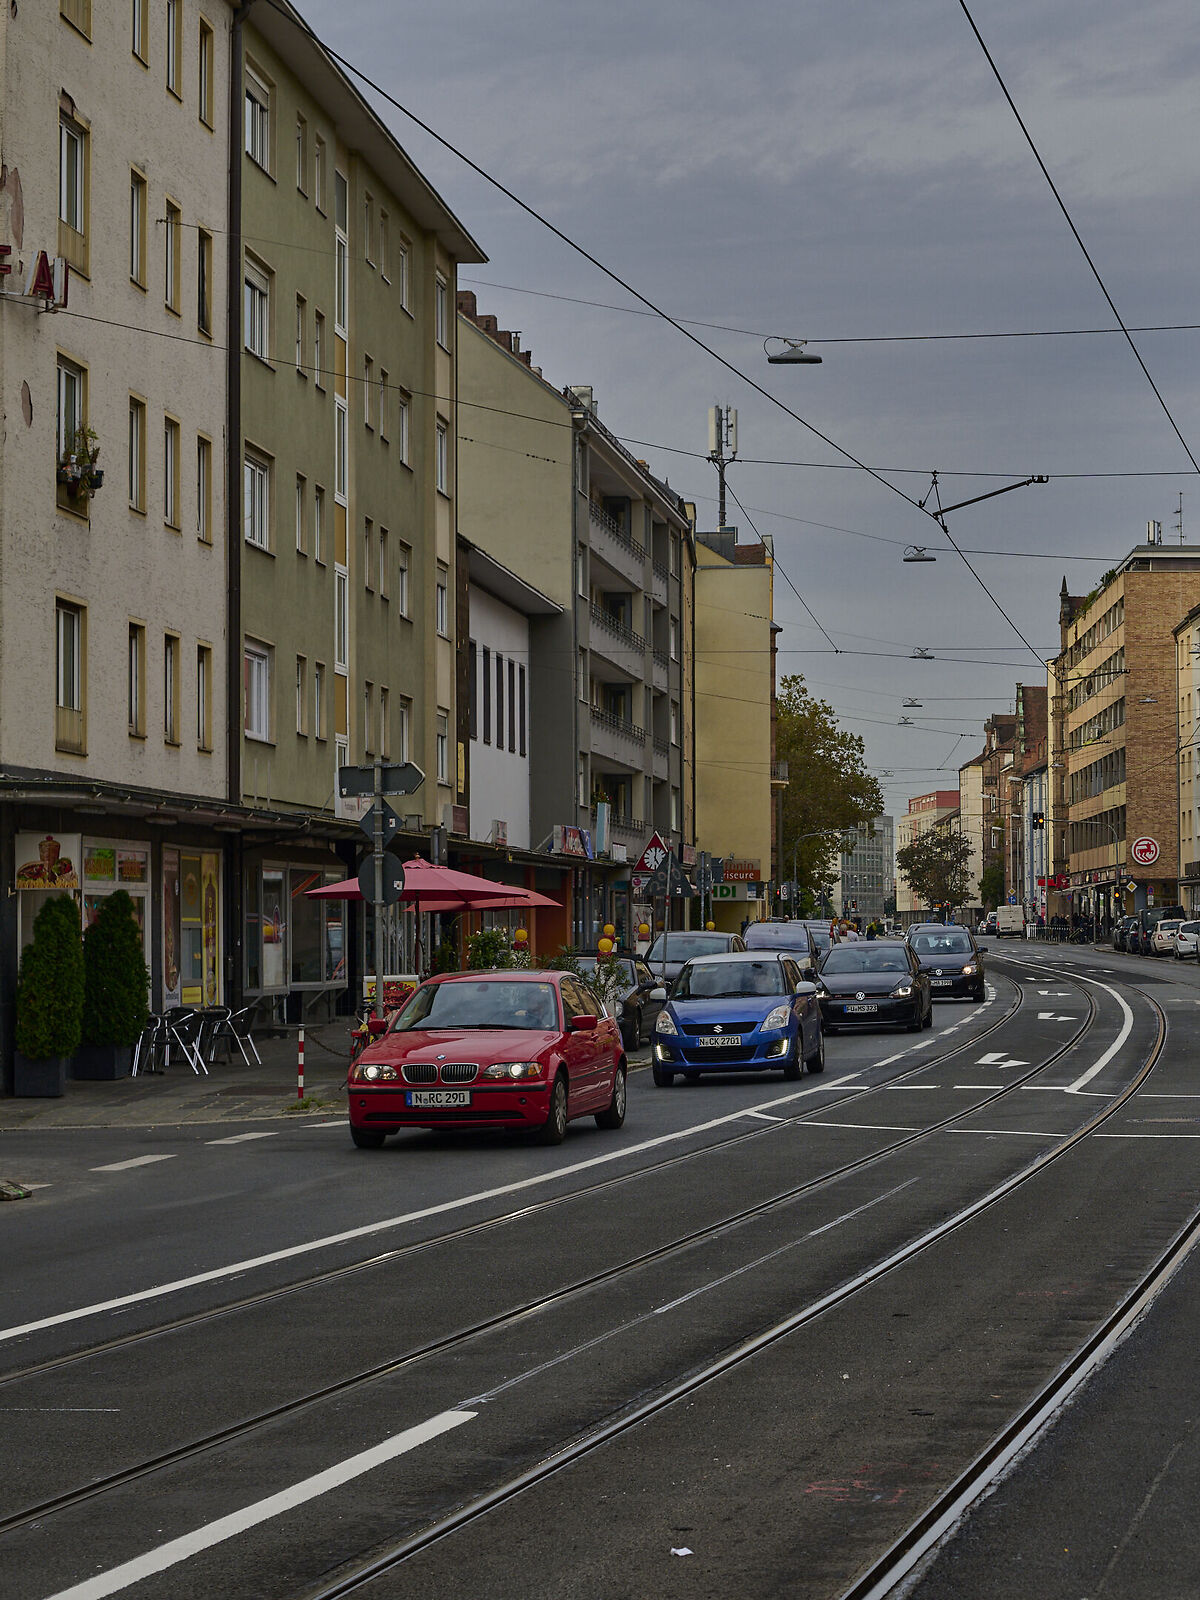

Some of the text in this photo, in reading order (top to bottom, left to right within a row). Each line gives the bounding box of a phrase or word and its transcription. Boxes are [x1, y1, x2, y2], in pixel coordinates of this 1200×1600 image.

[699, 1036, 740, 1046] N CK 2701
[415, 1092, 465, 1104] N RC 290
